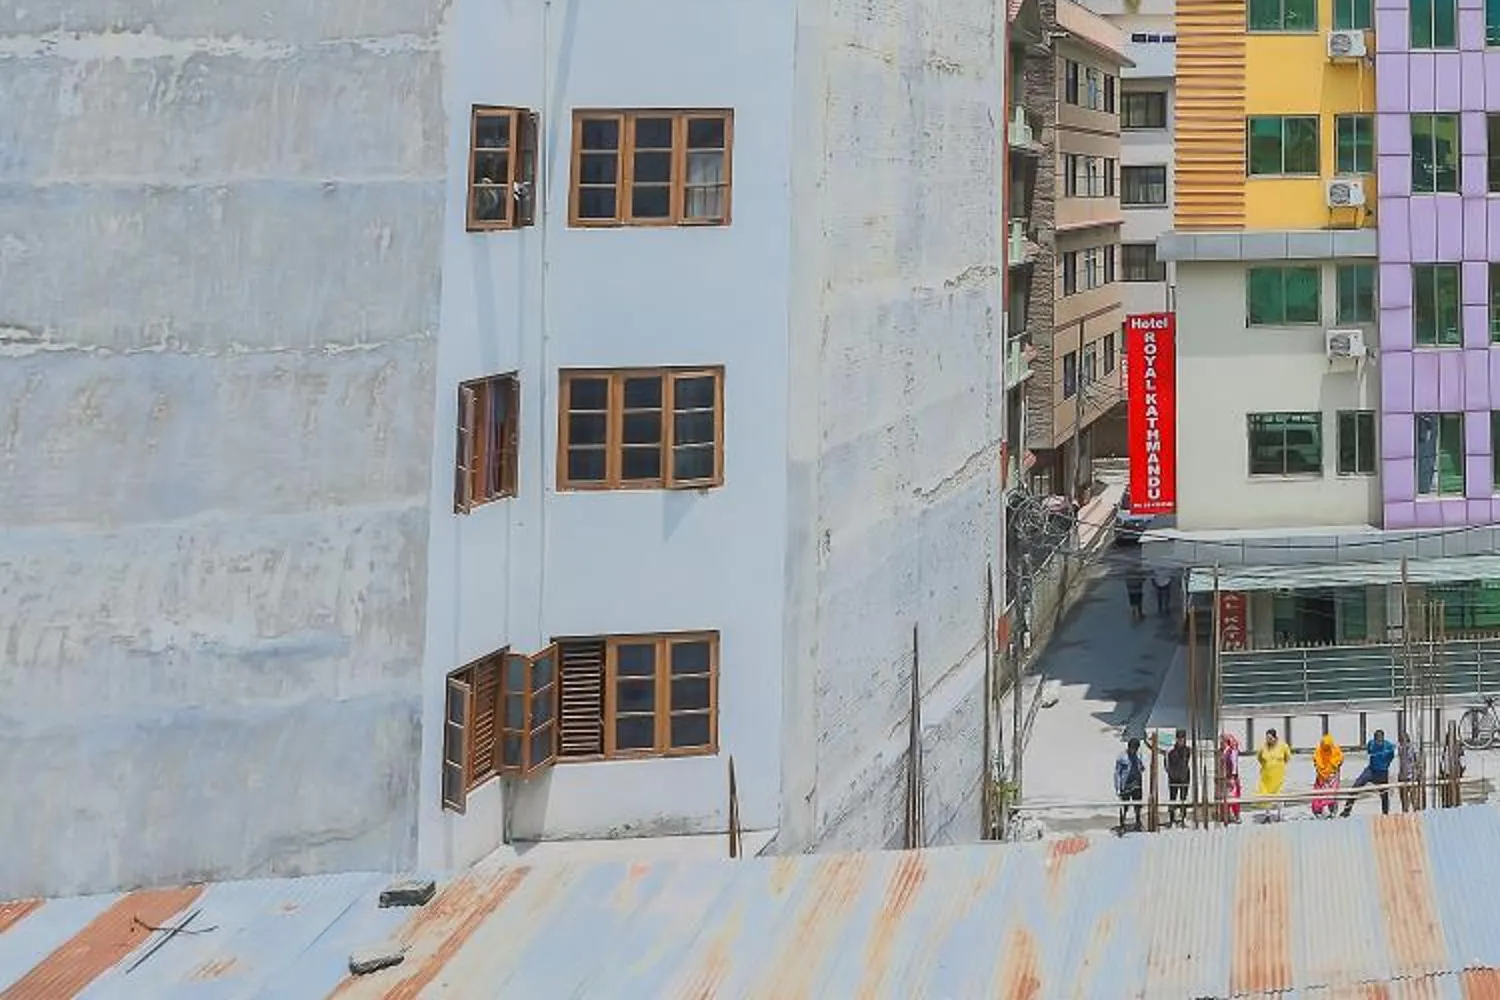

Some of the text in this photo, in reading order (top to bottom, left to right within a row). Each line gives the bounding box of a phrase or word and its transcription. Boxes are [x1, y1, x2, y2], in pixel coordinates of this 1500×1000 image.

[1131, 317, 1168, 330] Hotel
[1143, 332, 1161, 500] ROYAL KATHMANDU
